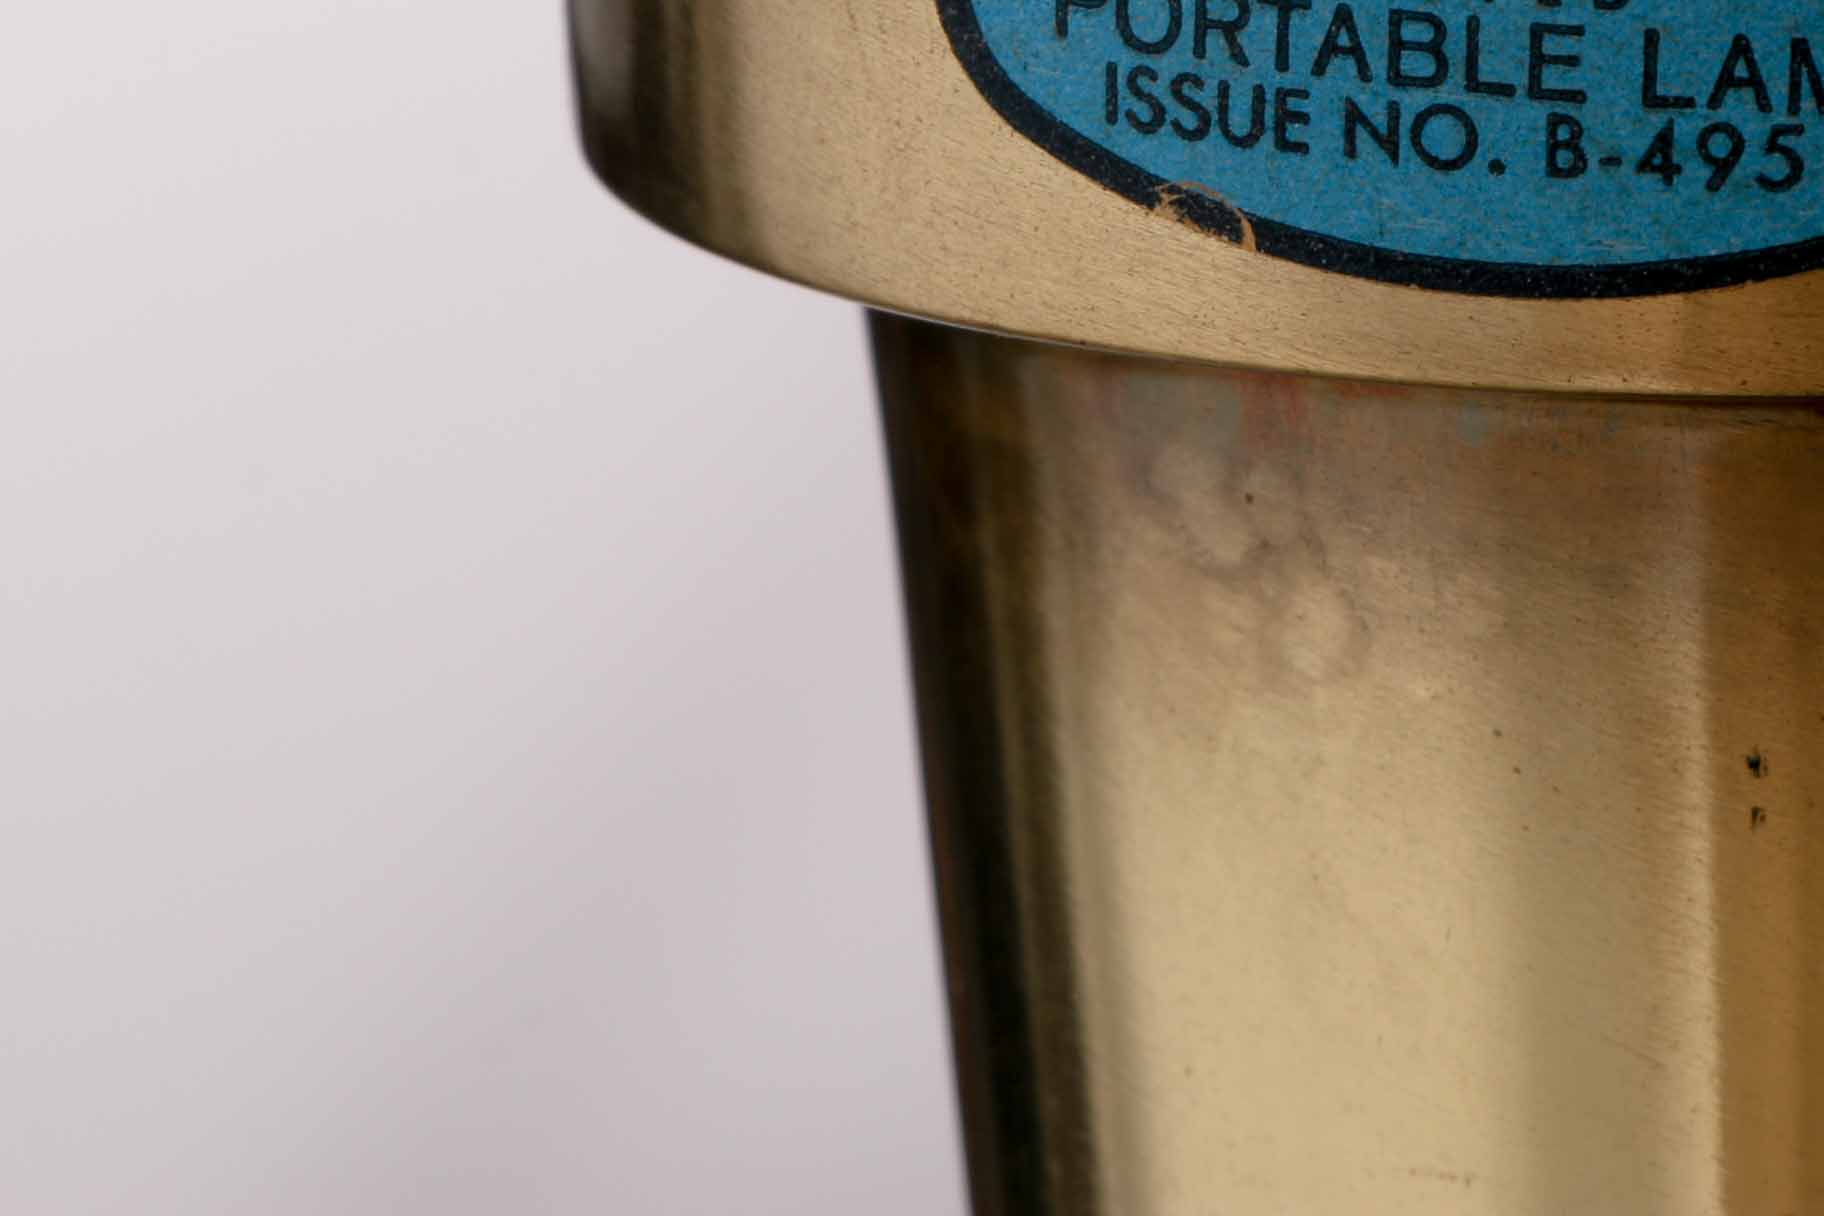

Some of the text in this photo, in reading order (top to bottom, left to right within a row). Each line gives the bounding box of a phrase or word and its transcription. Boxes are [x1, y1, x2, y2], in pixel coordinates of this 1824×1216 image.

[1104, 61, 1806, 194] ISSUE NO. B-495
